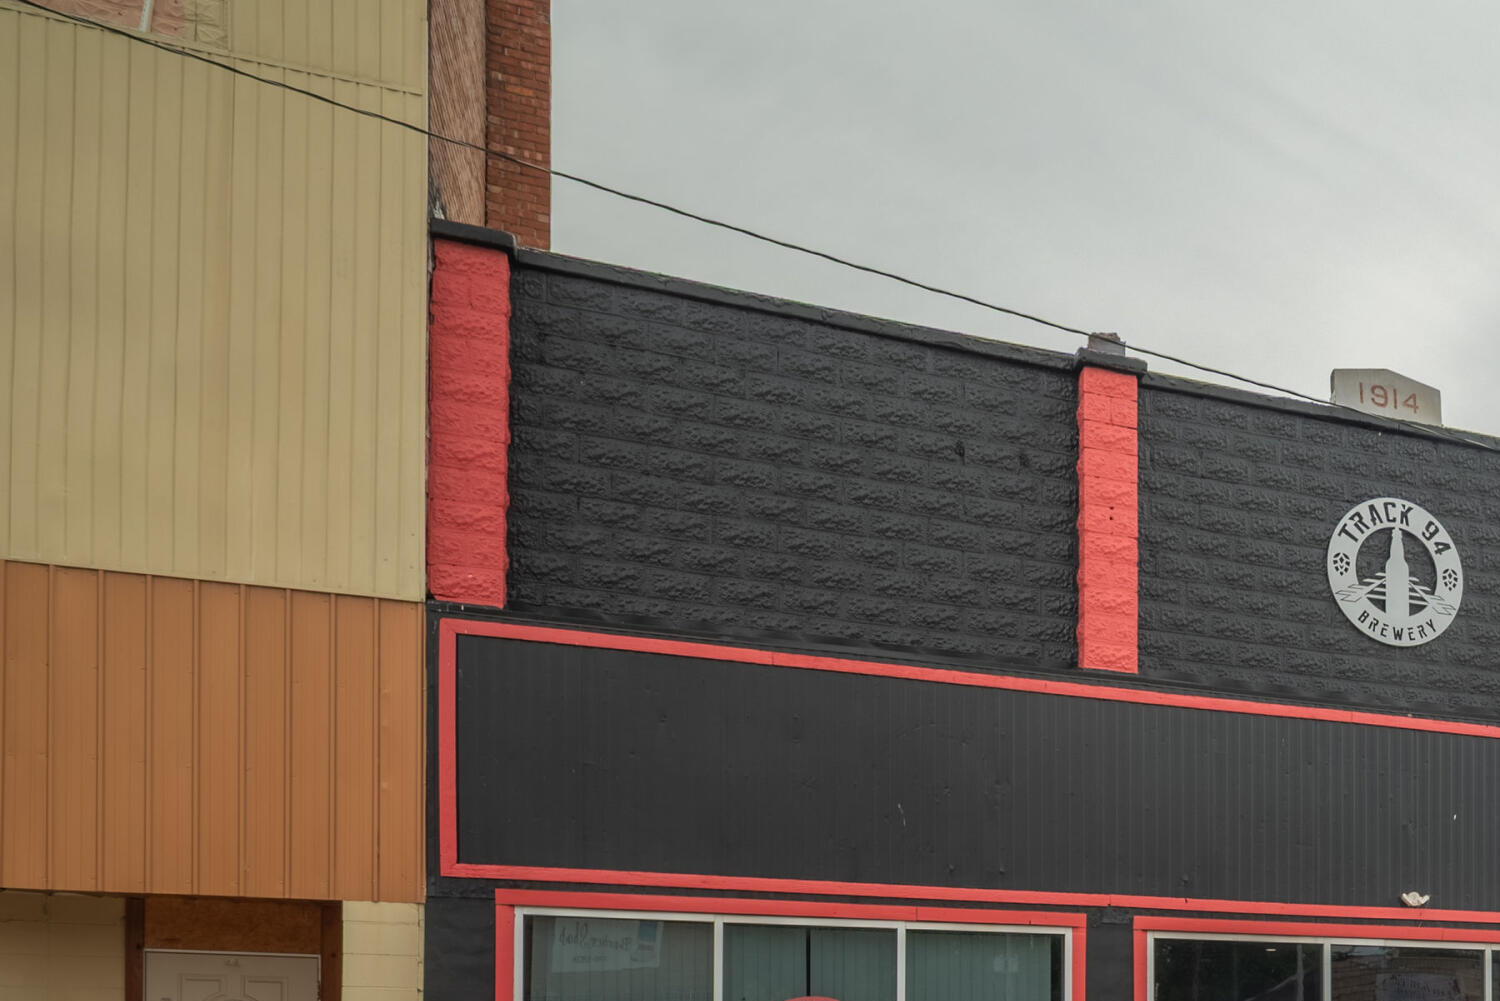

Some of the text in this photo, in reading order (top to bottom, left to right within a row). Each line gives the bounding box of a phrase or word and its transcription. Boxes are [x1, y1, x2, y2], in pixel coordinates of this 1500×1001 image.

[1358, 381, 1420, 414] 1914
[1337, 501, 1452, 556] TRACK 94
[1357, 609, 1437, 642] BREWERY
